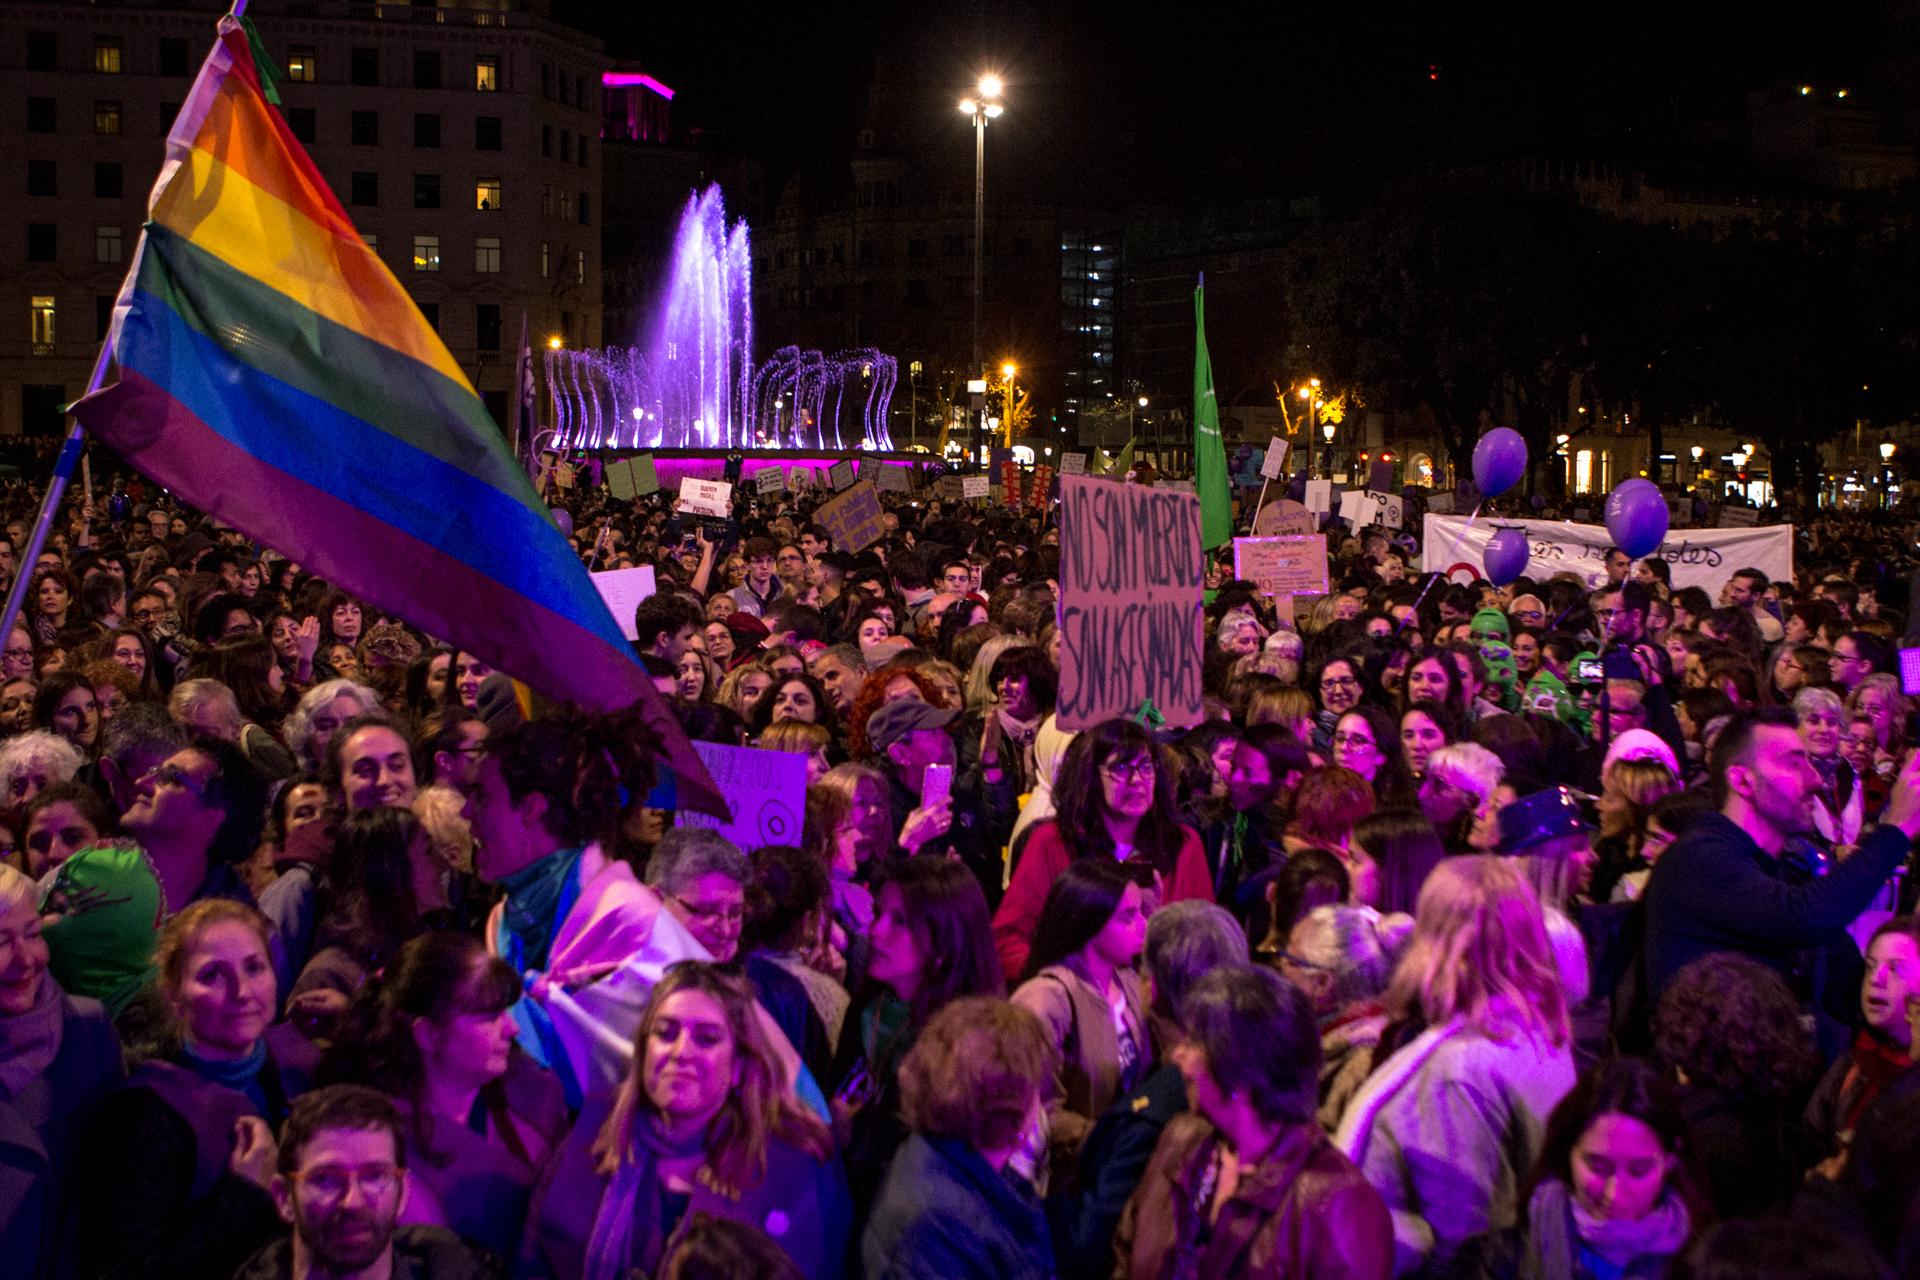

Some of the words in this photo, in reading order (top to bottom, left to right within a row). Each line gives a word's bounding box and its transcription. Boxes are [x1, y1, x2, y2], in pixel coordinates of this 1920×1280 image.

[1063, 483, 1093, 593] NO
[1093, 486, 1129, 594] SON
[1130, 489, 1203, 588] MUERTAS
[1056, 605, 1108, 720] SON
